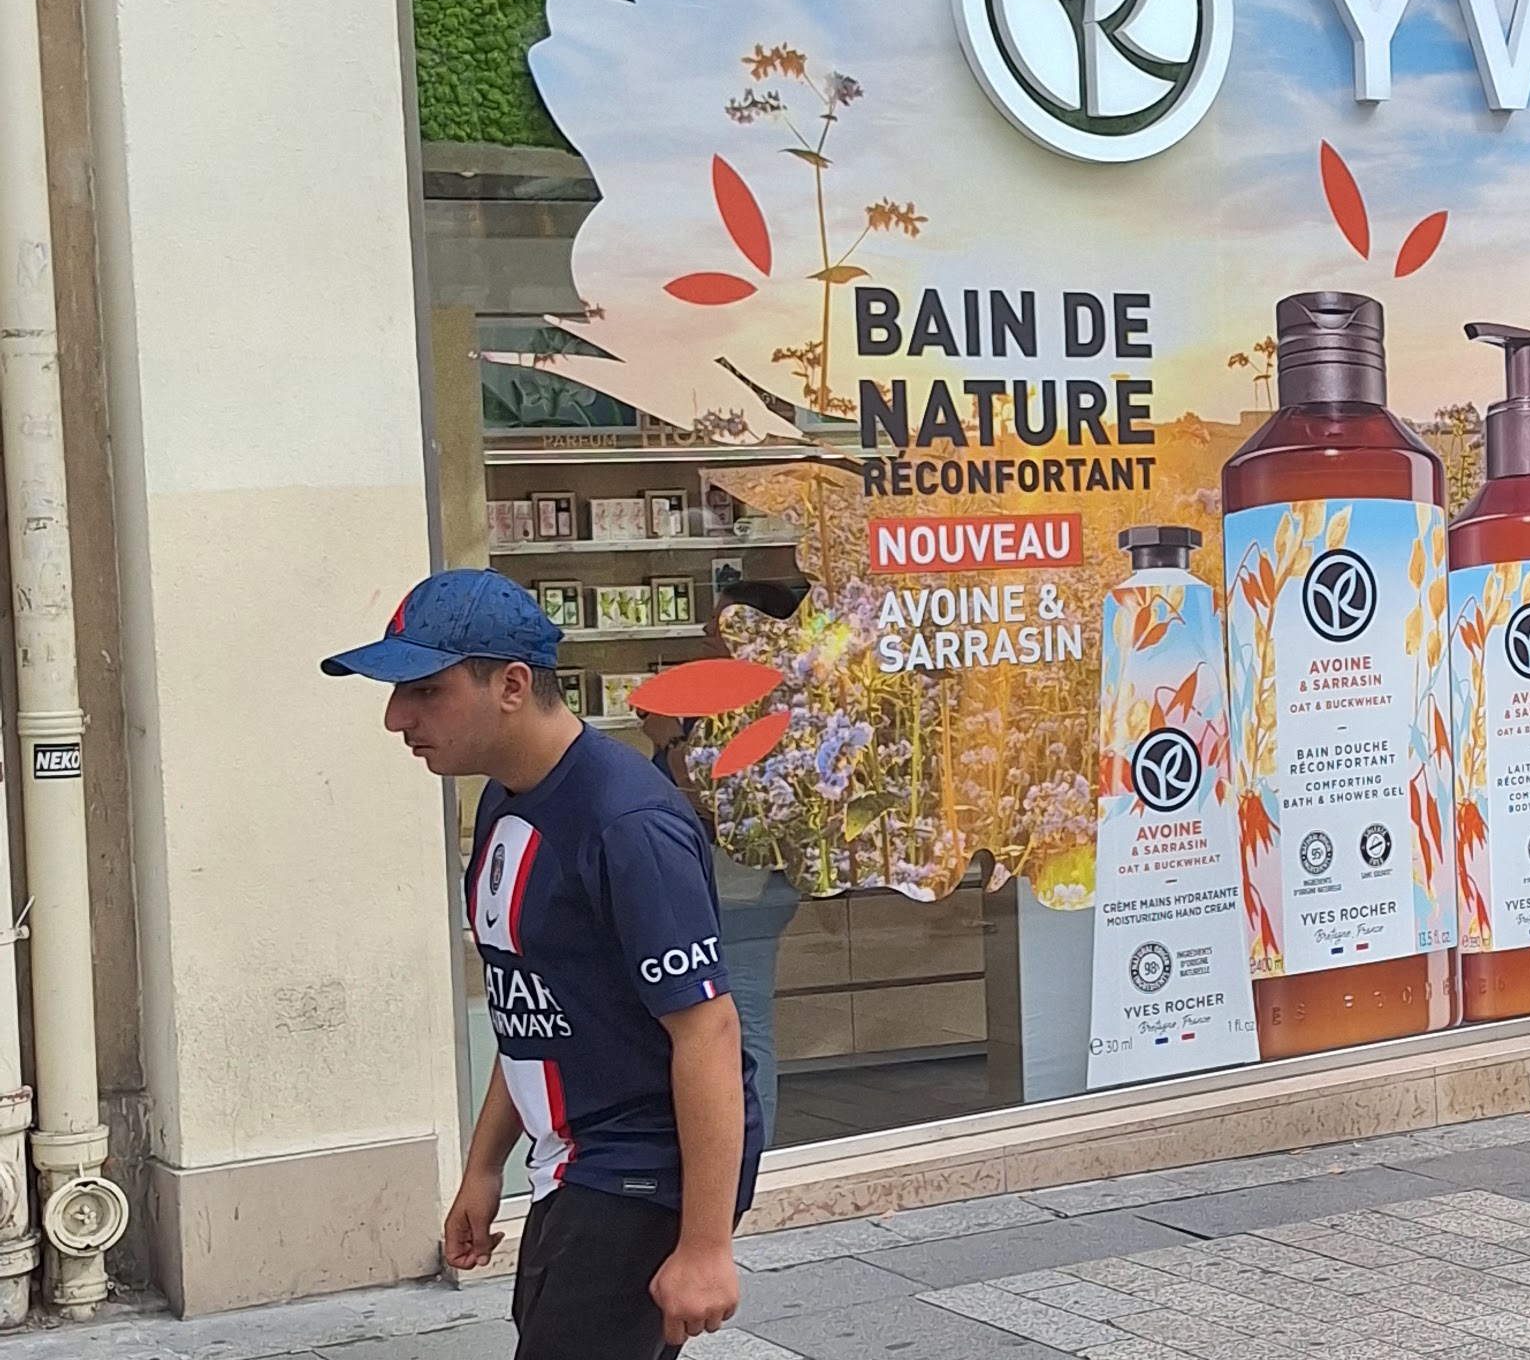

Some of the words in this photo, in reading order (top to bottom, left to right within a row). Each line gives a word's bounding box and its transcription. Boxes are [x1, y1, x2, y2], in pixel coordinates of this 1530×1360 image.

[854, 286, 1038, 357] BAIN
[1062, 291, 1153, 358] DE
[859, 379, 1156, 449] NATURE
[543, 433, 617, 448] PARFUM
[862, 449, 1156, 497] RÉCONFORTANT
[877, 520, 1071, 566] NOUVEAU
[877, 584, 1026, 630] AVOINE
[1037, 583, 1067, 622] &
[878, 624, 1084, 674] SARRASIN
[1309, 656, 1372, 675] AVOINE
[1299, 680, 1308, 692] &
[1313, 674, 1382, 691] SARRASIN
[1290, 702, 1311, 714] OAT
[1325, 695, 1393, 710] BUCKWHEAT
[1496, 727, 1514, 737] OAT
[36, 750, 80, 770] NEKO
[1297, 746, 1329, 760] BAIN
[1335, 740, 1389, 756] DOUCHE
[1290, 753, 1396, 775] RÉCONFORTANT
[1508, 763, 1530, 775] LAIT
[1305, 774, 1382, 792] COMFORTING
[1283, 796, 1313, 809] BATH
[1329, 789, 1378, 804] SHOWER
[1383, 785, 1405, 798] GEL
[1136, 820, 1202, 842] AVOINE
[1144, 838, 1208, 855] SARRASIN
[1118, 864, 1140, 874] OAT
[1154, 854, 1221, 871] BUCKWHEAT
[1102, 899, 1137, 914] CRÈME
[1140, 896, 1172, 909] MAINS
[1174, 886, 1239, 905] HYDRATANTE
[1107, 910, 1174, 927] MOISTURIZING
[1175, 906, 1201, 919] HAND
[1204, 901, 1236, 914] CREAM
[1300, 910, 1336, 927] YVES
[1340, 901, 1397, 922] ROCHER
[640, 936, 719, 983] GOAT
[486, 963, 563, 1011] ATAR
[1124, 1003, 1160, 1020] YVES
[1165, 993, 1224, 1013] ROCHER
[491, 1007, 572, 1038] RWAYS
[1106, 1038, 1119, 1053] 30
